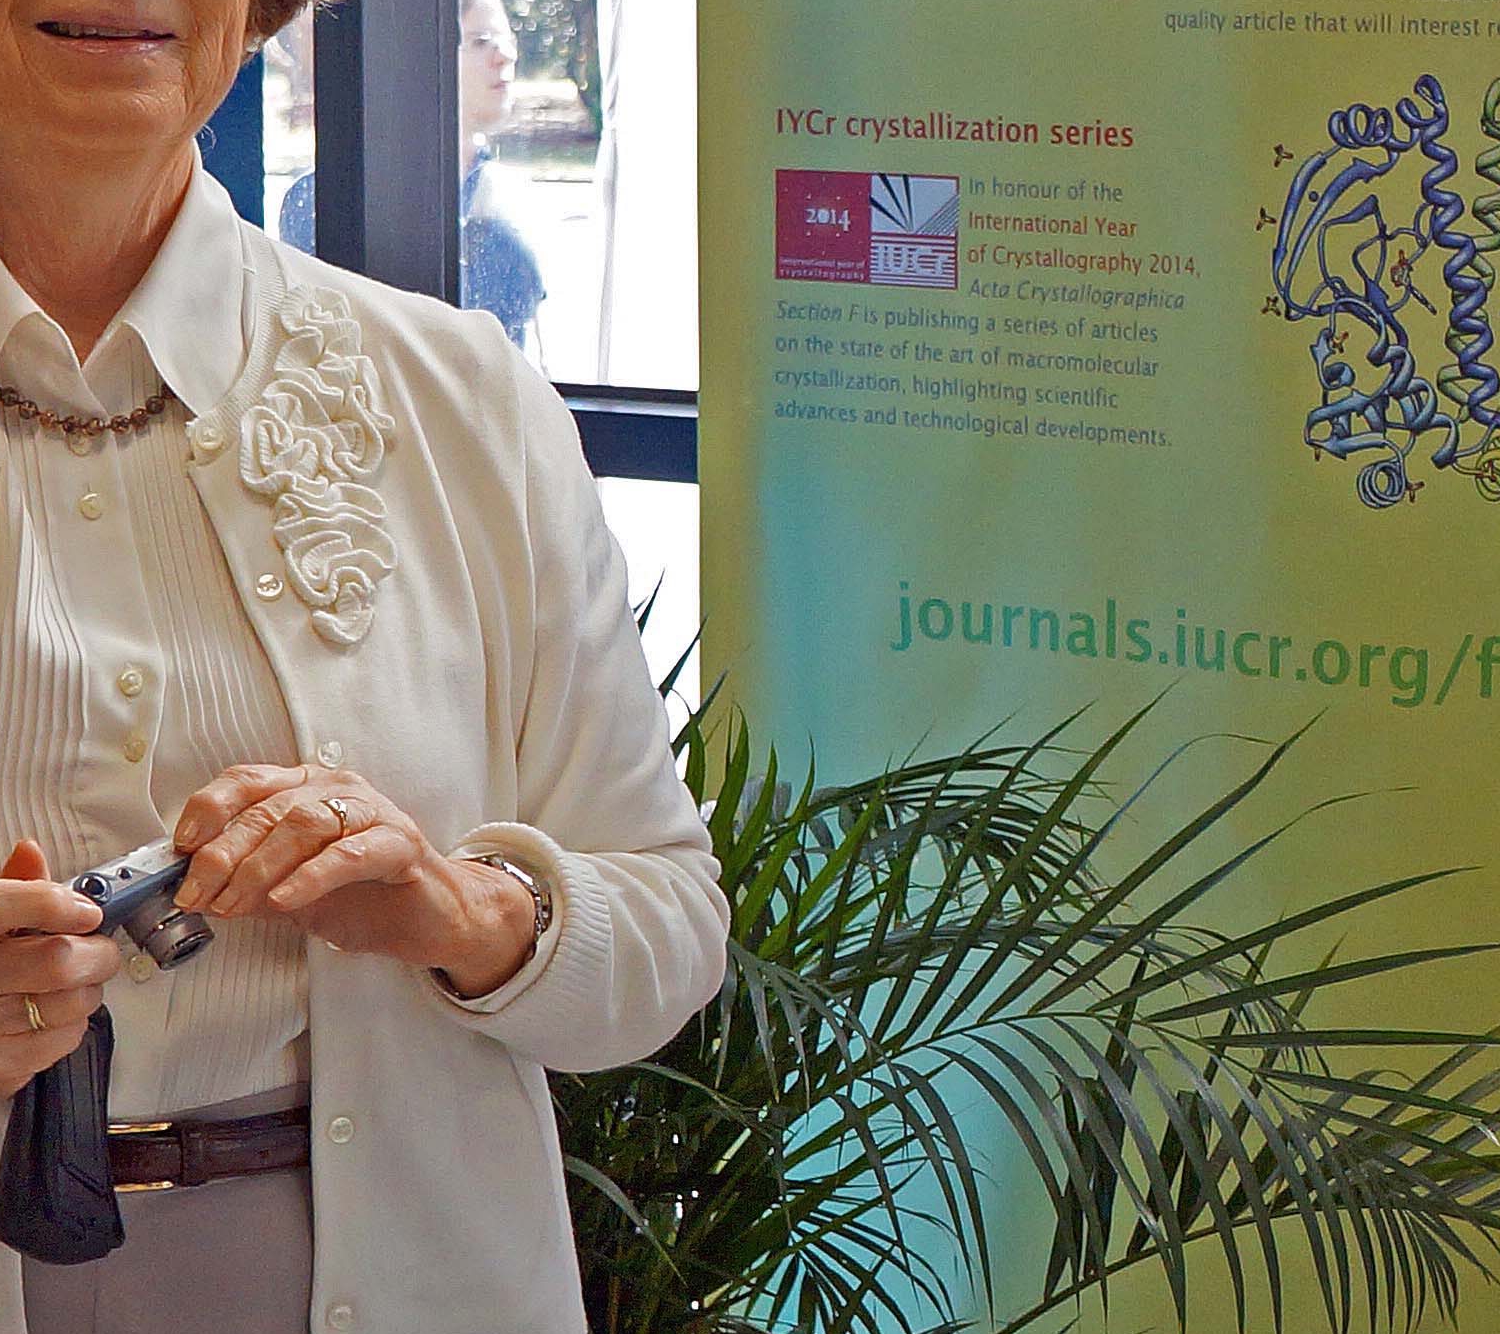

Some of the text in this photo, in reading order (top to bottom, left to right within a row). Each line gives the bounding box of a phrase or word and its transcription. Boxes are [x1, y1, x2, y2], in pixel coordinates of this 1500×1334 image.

[778, 108, 1133, 147] IYCr crystallization series
